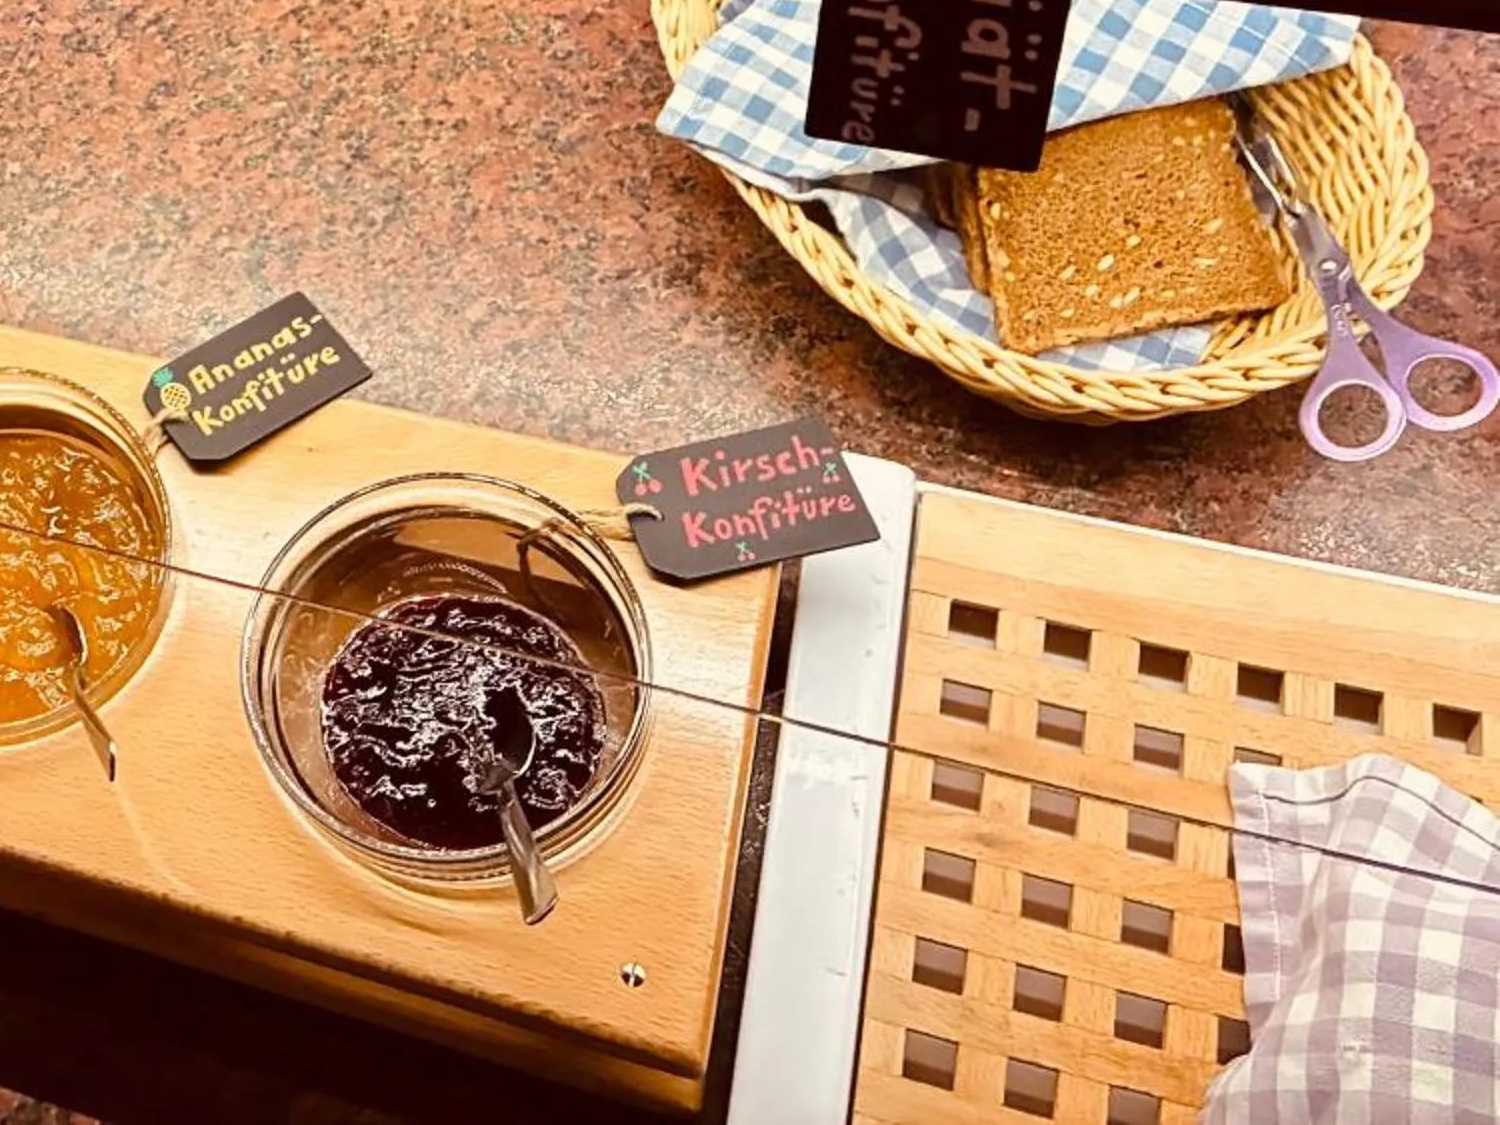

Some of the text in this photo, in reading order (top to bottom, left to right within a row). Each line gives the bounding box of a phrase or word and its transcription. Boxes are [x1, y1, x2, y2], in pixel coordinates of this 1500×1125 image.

[188, 313, 325, 395] Ananas-
[191, 345, 341, 436] Konfitüre
[679, 434, 836, 497] Kirsch-
[681, 485, 856, 548] Konfitüre
